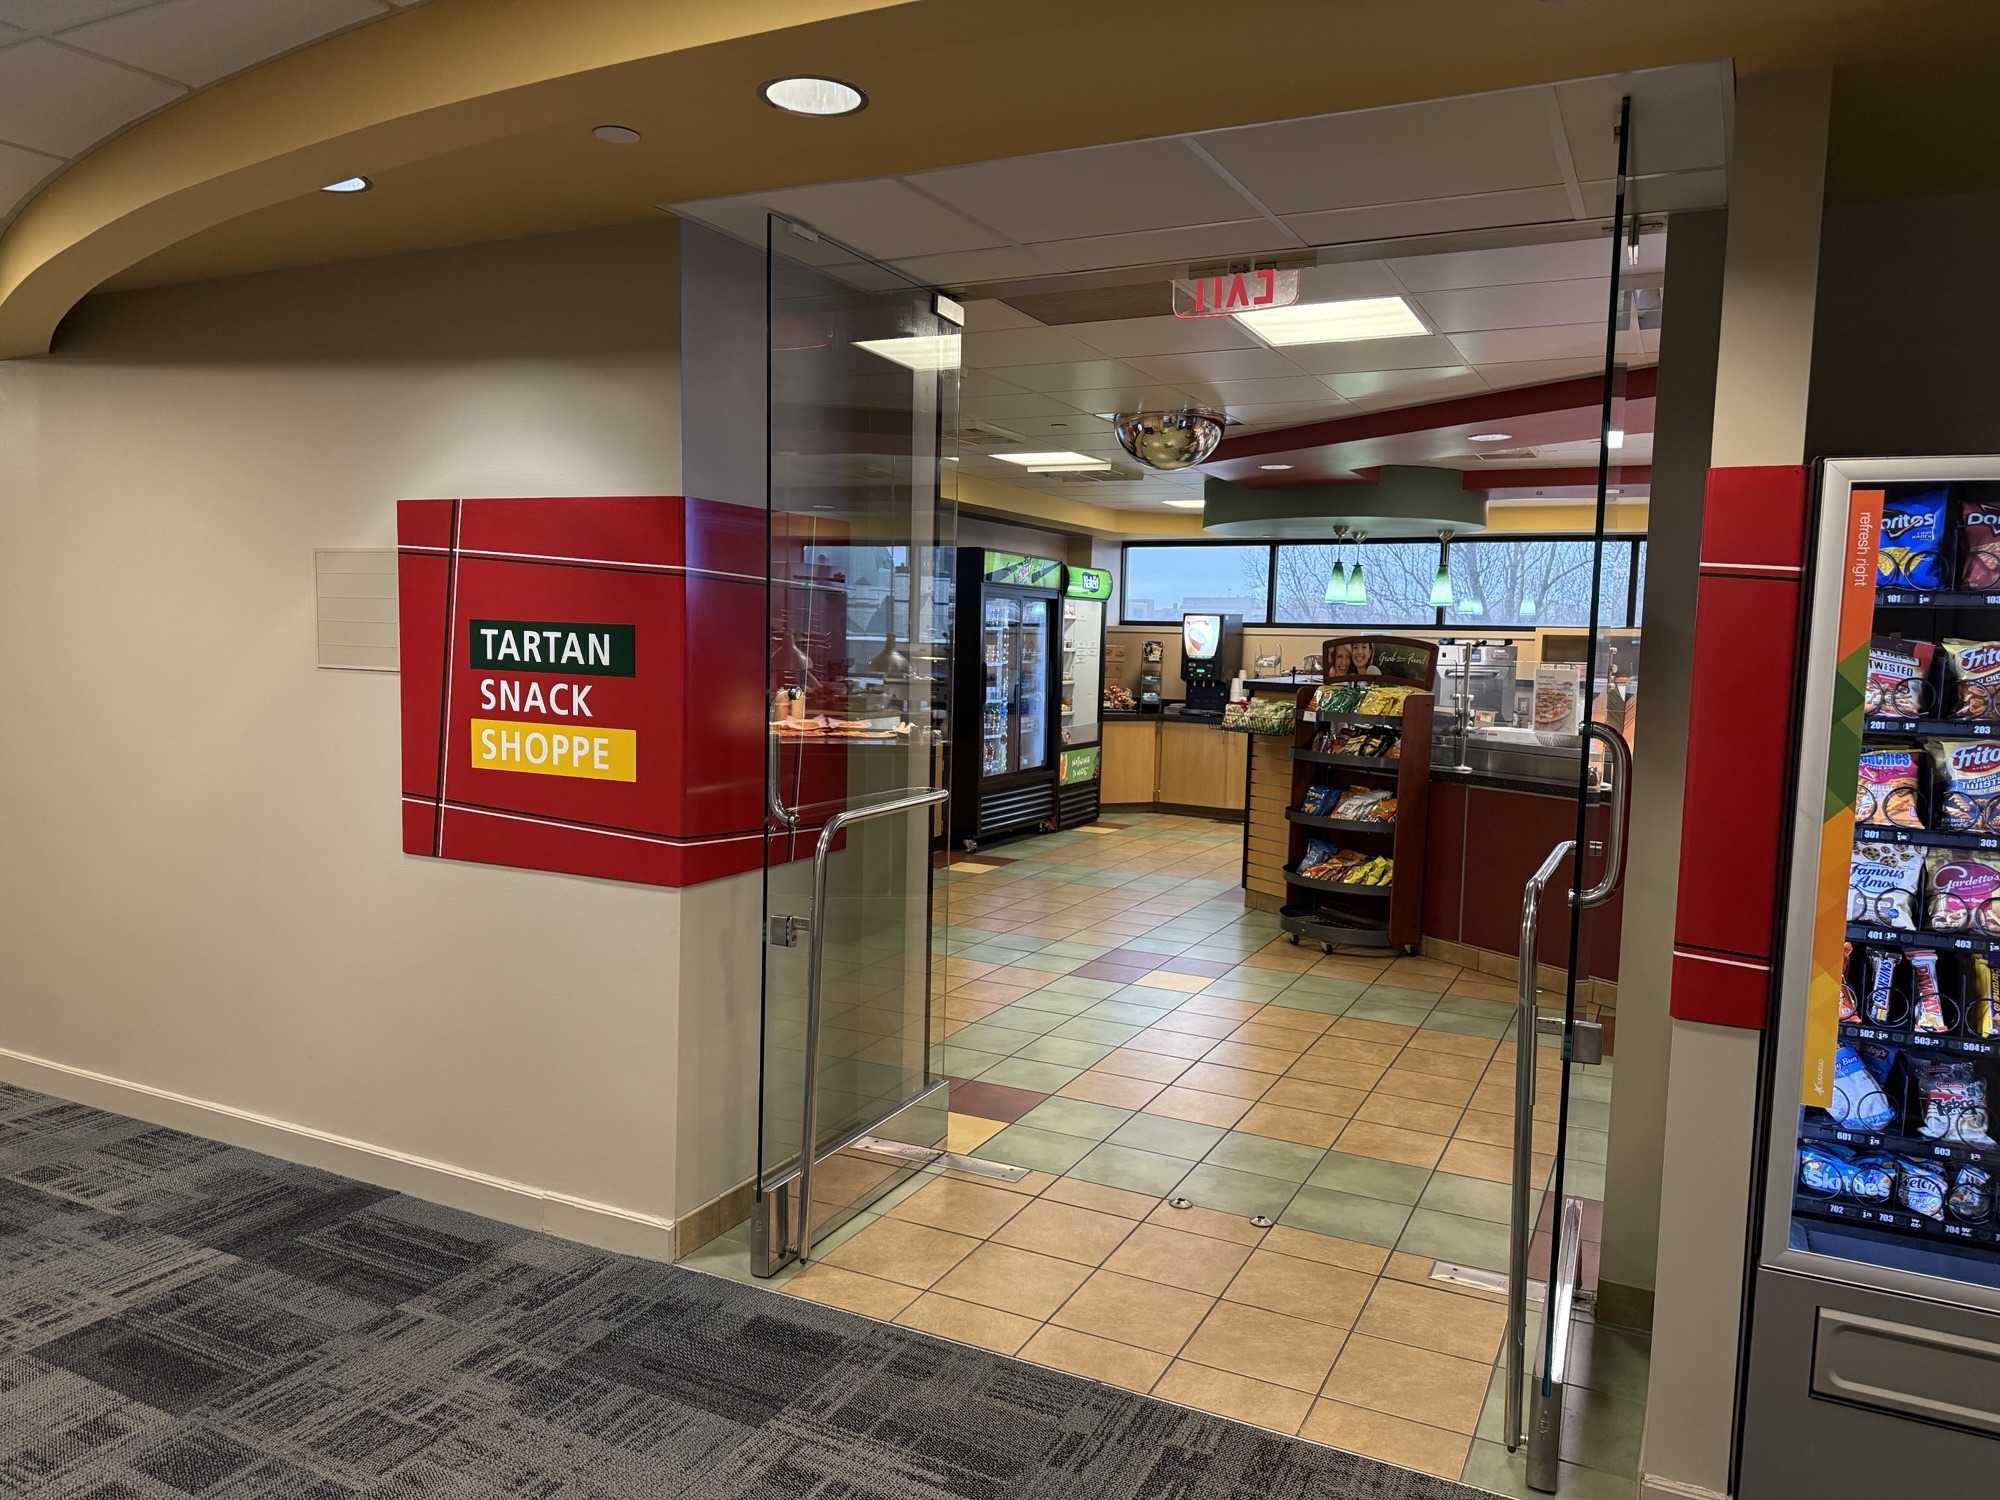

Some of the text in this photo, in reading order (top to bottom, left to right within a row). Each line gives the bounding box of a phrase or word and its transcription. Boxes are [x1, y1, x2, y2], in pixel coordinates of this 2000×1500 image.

[1852, 511, 1873, 587] refresh right
[1887, 594, 1901, 603] 101
[480, 628, 610, 666] TARTAN
[1379, 651, 1396, 666] Grab
[480, 678, 593, 717] SNACK
[1870, 721, 1885, 730] 201
[1974, 726, 1990, 734] 203
[481, 728, 609, 770] SHOPPE
[1865, 830, 1879, 839] 301
[1980, 838, 1998, 848] 303
[1851, 863, 1905, 880] Famous
[1856, 876, 1895, 889] Amos
[1933, 865, 2000, 893] Gardetto's
[1868, 931, 1883, 940] 401
[1955, 940, 1972, 949] 403
[1873, 958, 1893, 1006] SNICKERS
[1860, 1029, 1875, 1039] 502
[1914, 1036, 1931, 1046] 503
[1963, 1042, 1979, 1052] 504
[1842, 1056, 1858, 1066] Bun
[1837, 1131, 1852, 1141] 601
[1934, 1146, 1951, 1157] 603
[1829, 1204, 1844, 1214] 702
[1879, 1213, 1894, 1223] 703
[1945, 1225, 1960, 1235] 704
